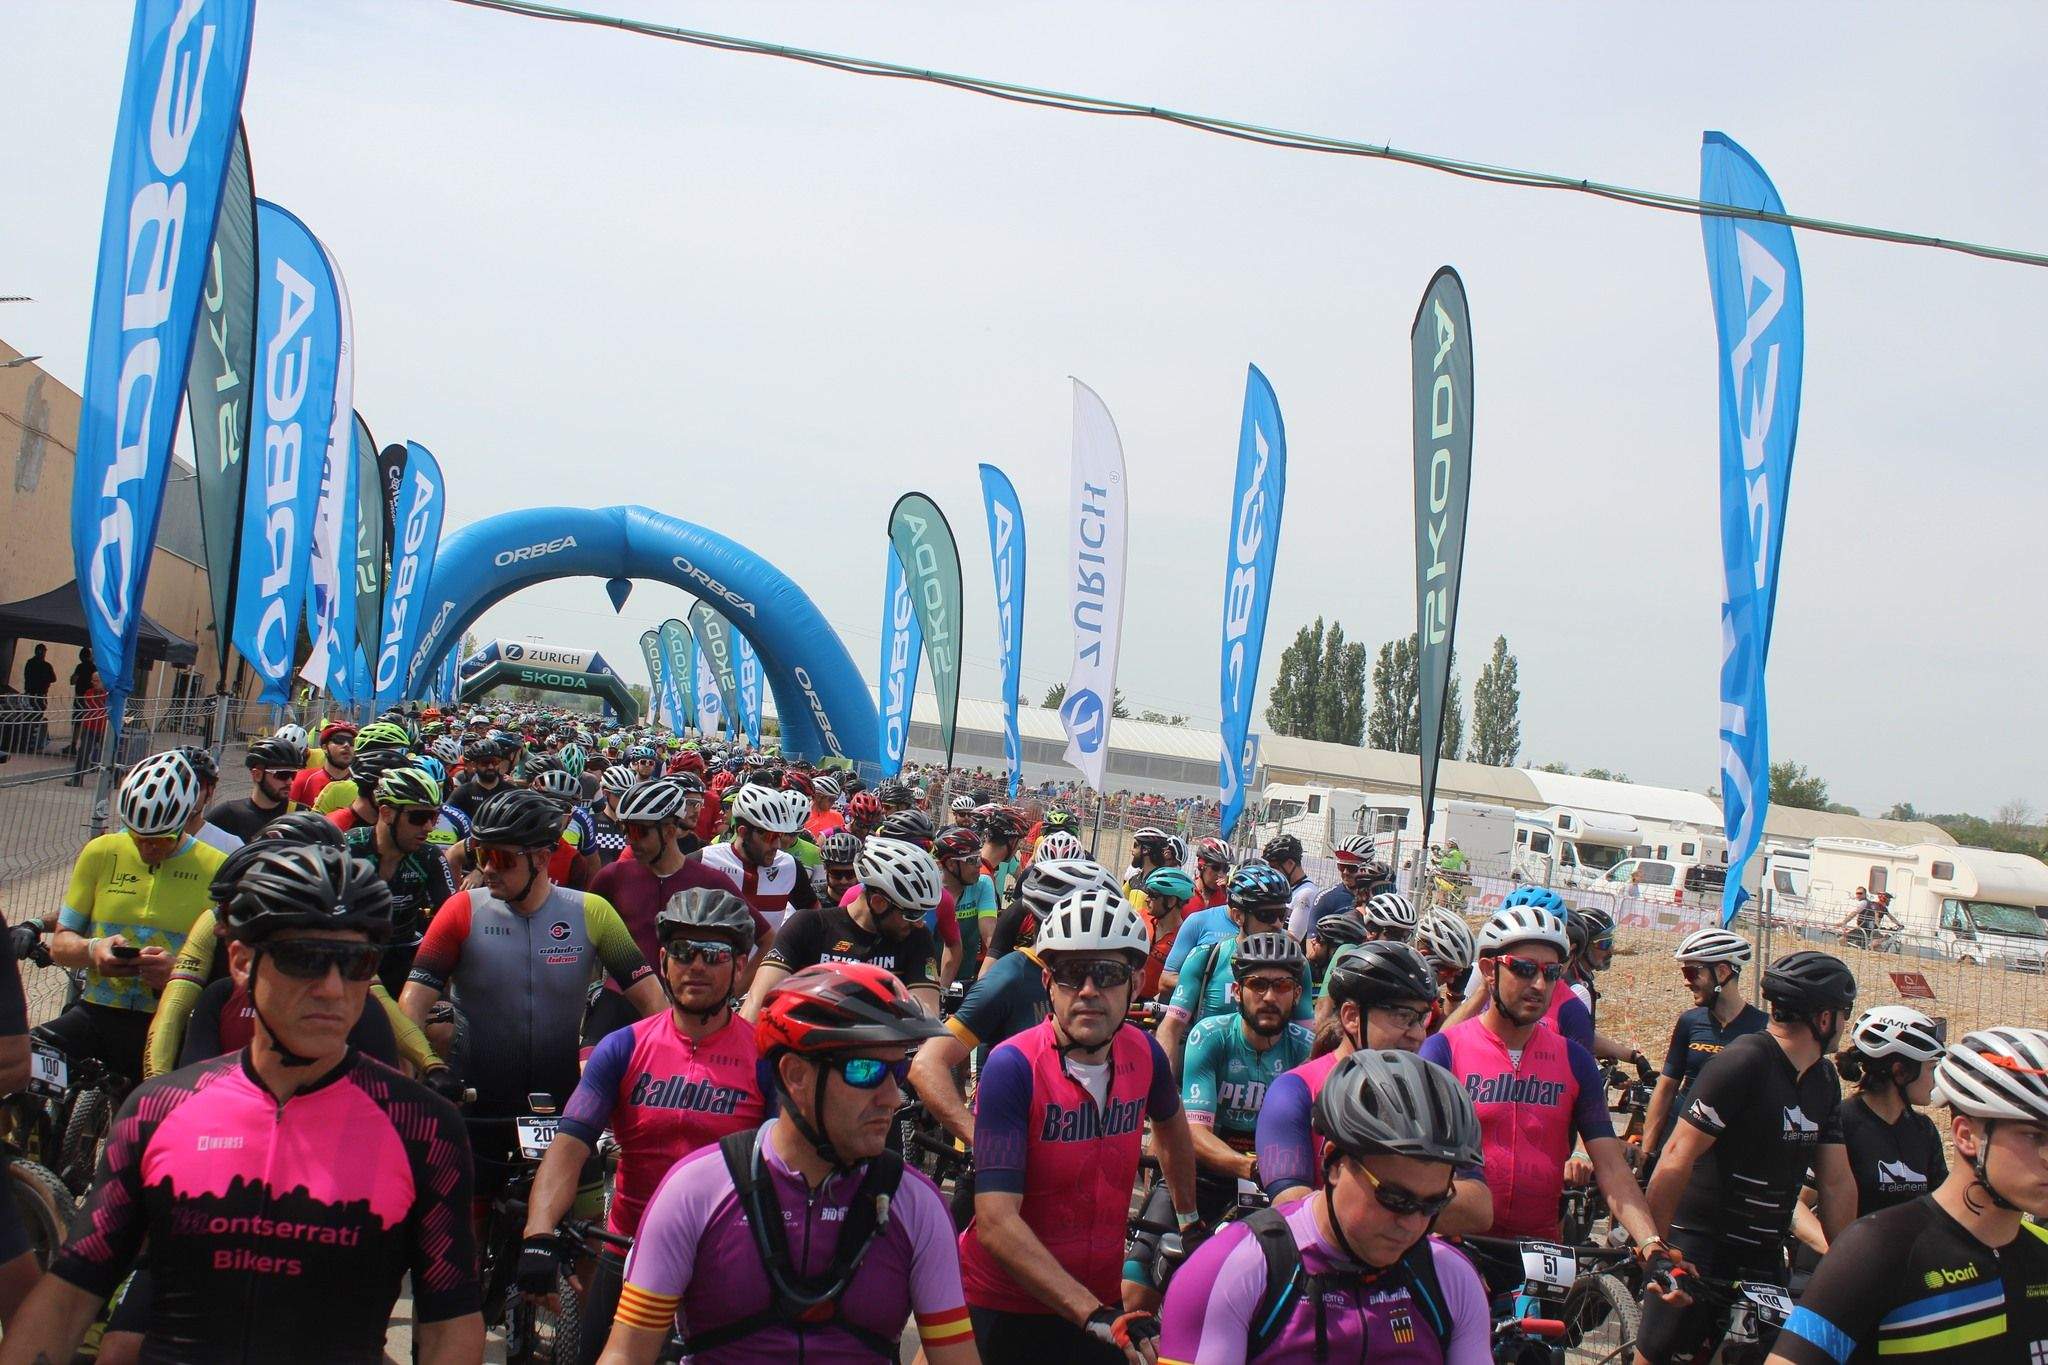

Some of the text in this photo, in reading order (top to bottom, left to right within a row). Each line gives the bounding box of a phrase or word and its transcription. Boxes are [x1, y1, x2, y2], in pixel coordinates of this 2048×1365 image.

[494, 535, 578, 567] ORBEA
[672, 556, 757, 619] ORBEA
[403, 600, 457, 694] RBEA
[529, 650, 581, 665] ZURICH
[520, 670, 588, 689] SKODA
[41, 1056, 59, 1077] 100
[629, 1071, 751, 1115] Ballobar
[1465, 1072, 1566, 1107] Ballobar
[213, 1249, 303, 1276] Bikers
[1543, 1254, 1558, 1276] 51
[1941, 1261, 1979, 1284] barri
